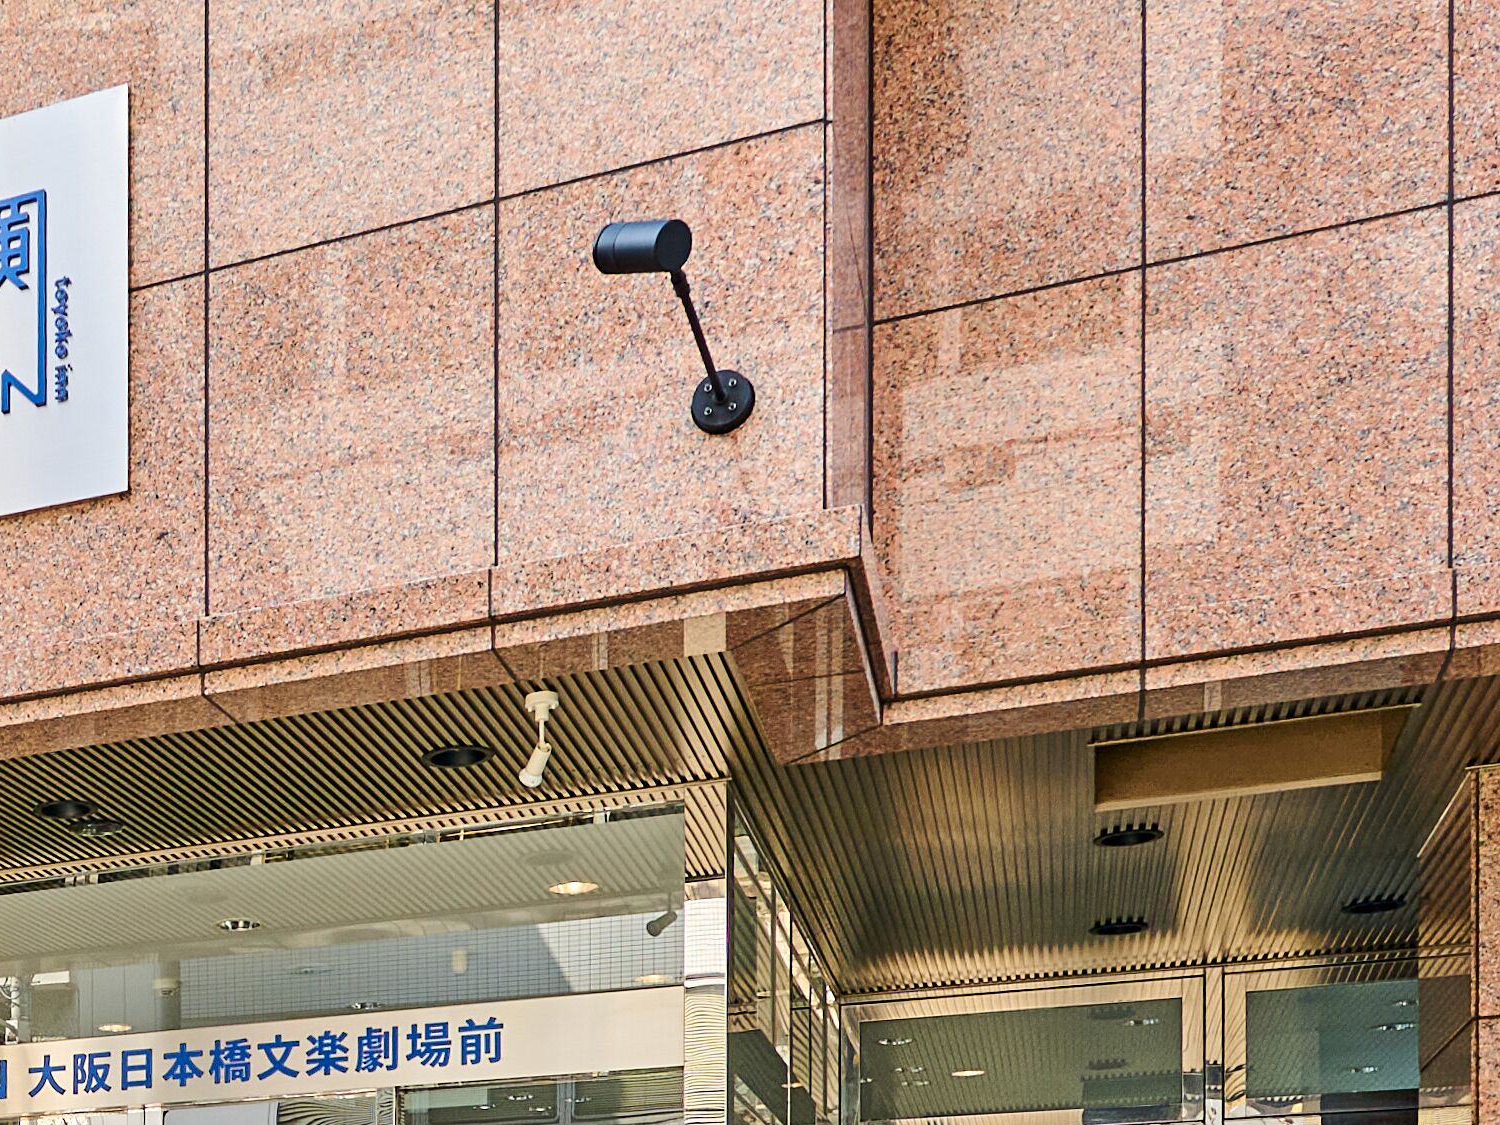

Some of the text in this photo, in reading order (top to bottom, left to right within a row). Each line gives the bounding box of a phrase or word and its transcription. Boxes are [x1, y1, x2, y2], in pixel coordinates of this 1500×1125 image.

[51, 275, 74, 403] toyoko inn
[28, 1016, 504, 1098] 大阪日本橋文楽劇場前
